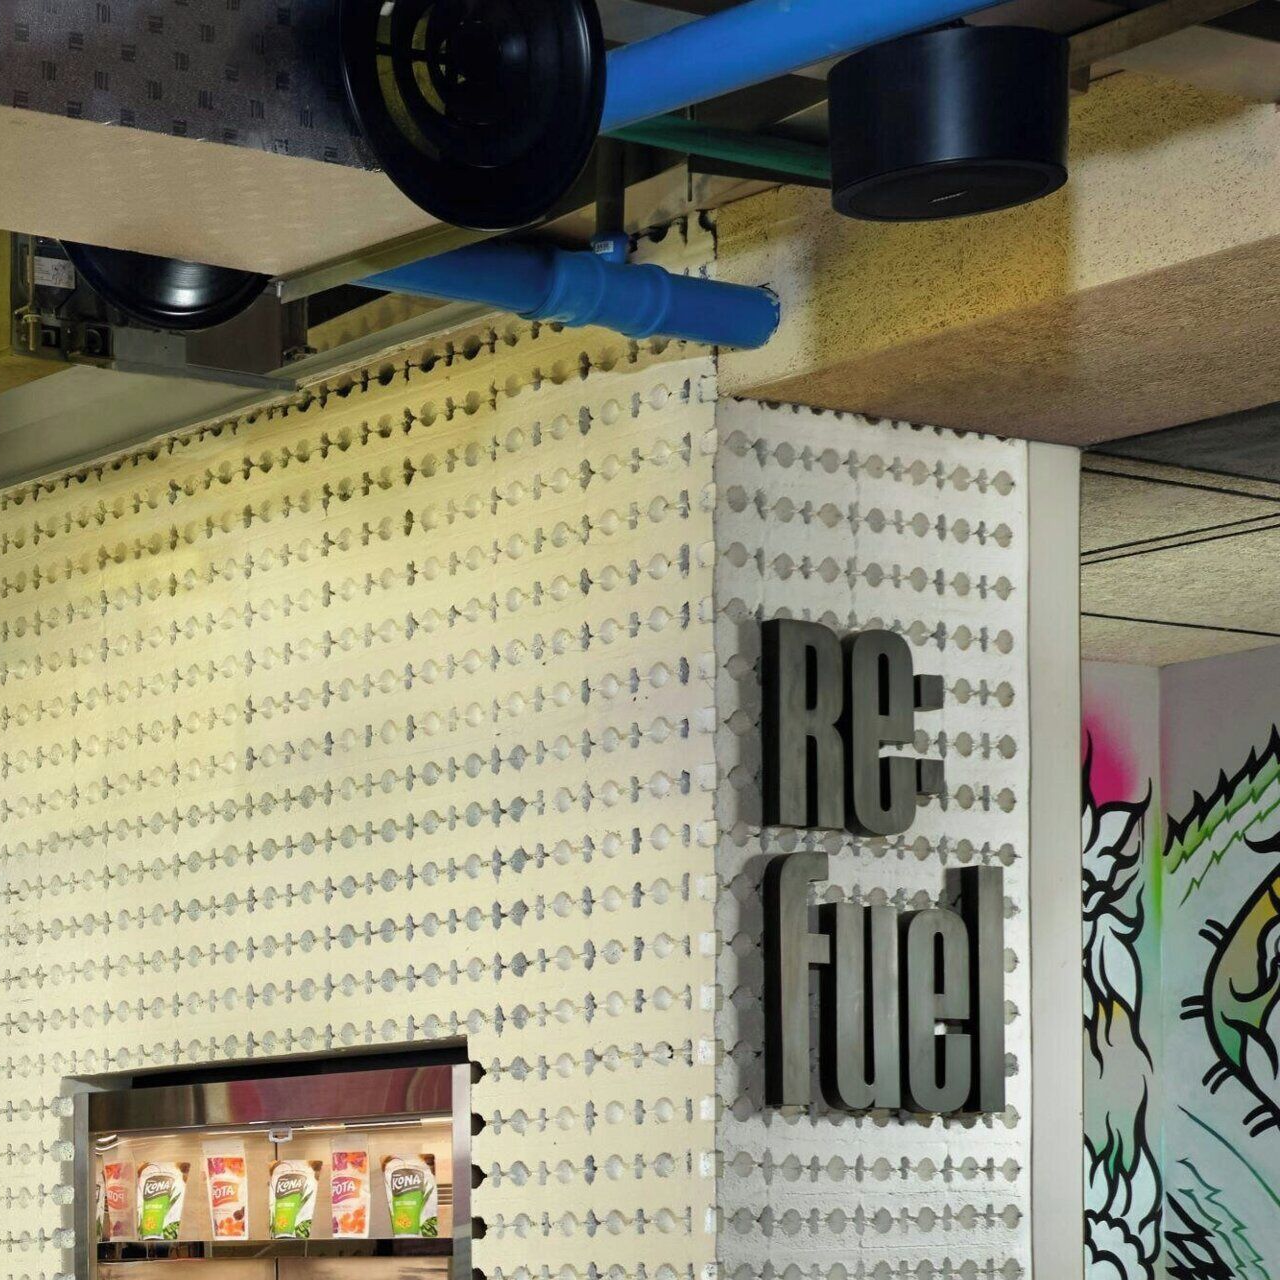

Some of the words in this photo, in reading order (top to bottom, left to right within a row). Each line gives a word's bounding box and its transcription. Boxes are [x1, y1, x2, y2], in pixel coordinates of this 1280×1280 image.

[145, 1181, 170, 1194] KONA
[277, 1179, 302, 1193] KONA
[392, 1174, 421, 1190] KONA
